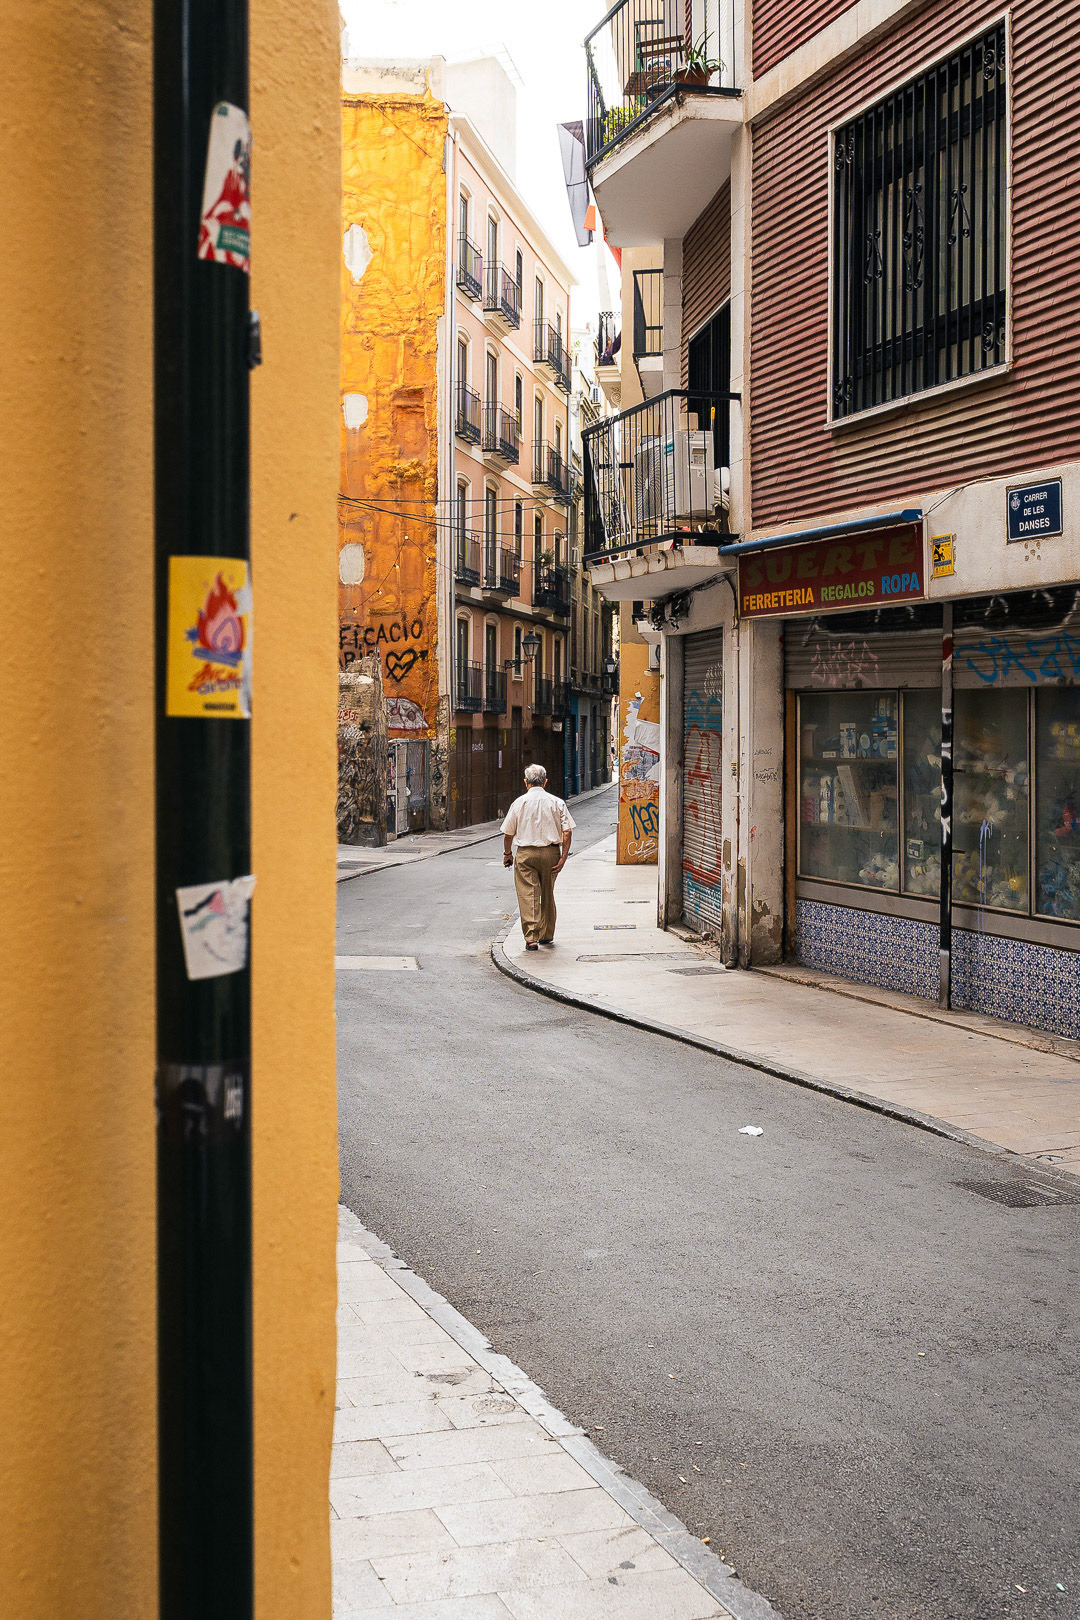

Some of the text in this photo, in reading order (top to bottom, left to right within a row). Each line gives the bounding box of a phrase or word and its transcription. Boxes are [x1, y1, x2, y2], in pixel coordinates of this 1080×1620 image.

[1023, 491, 1048, 503] CARRER
[1023, 505, 1045, 516] DE LES
[1019, 517, 1050, 532] DANSES
[745, 534, 917, 586] SUERTE
[743, 587, 815, 611] FERRETERIA
[820, 580, 875, 602] REGALOS
[881, 572, 920, 595] ROPA
